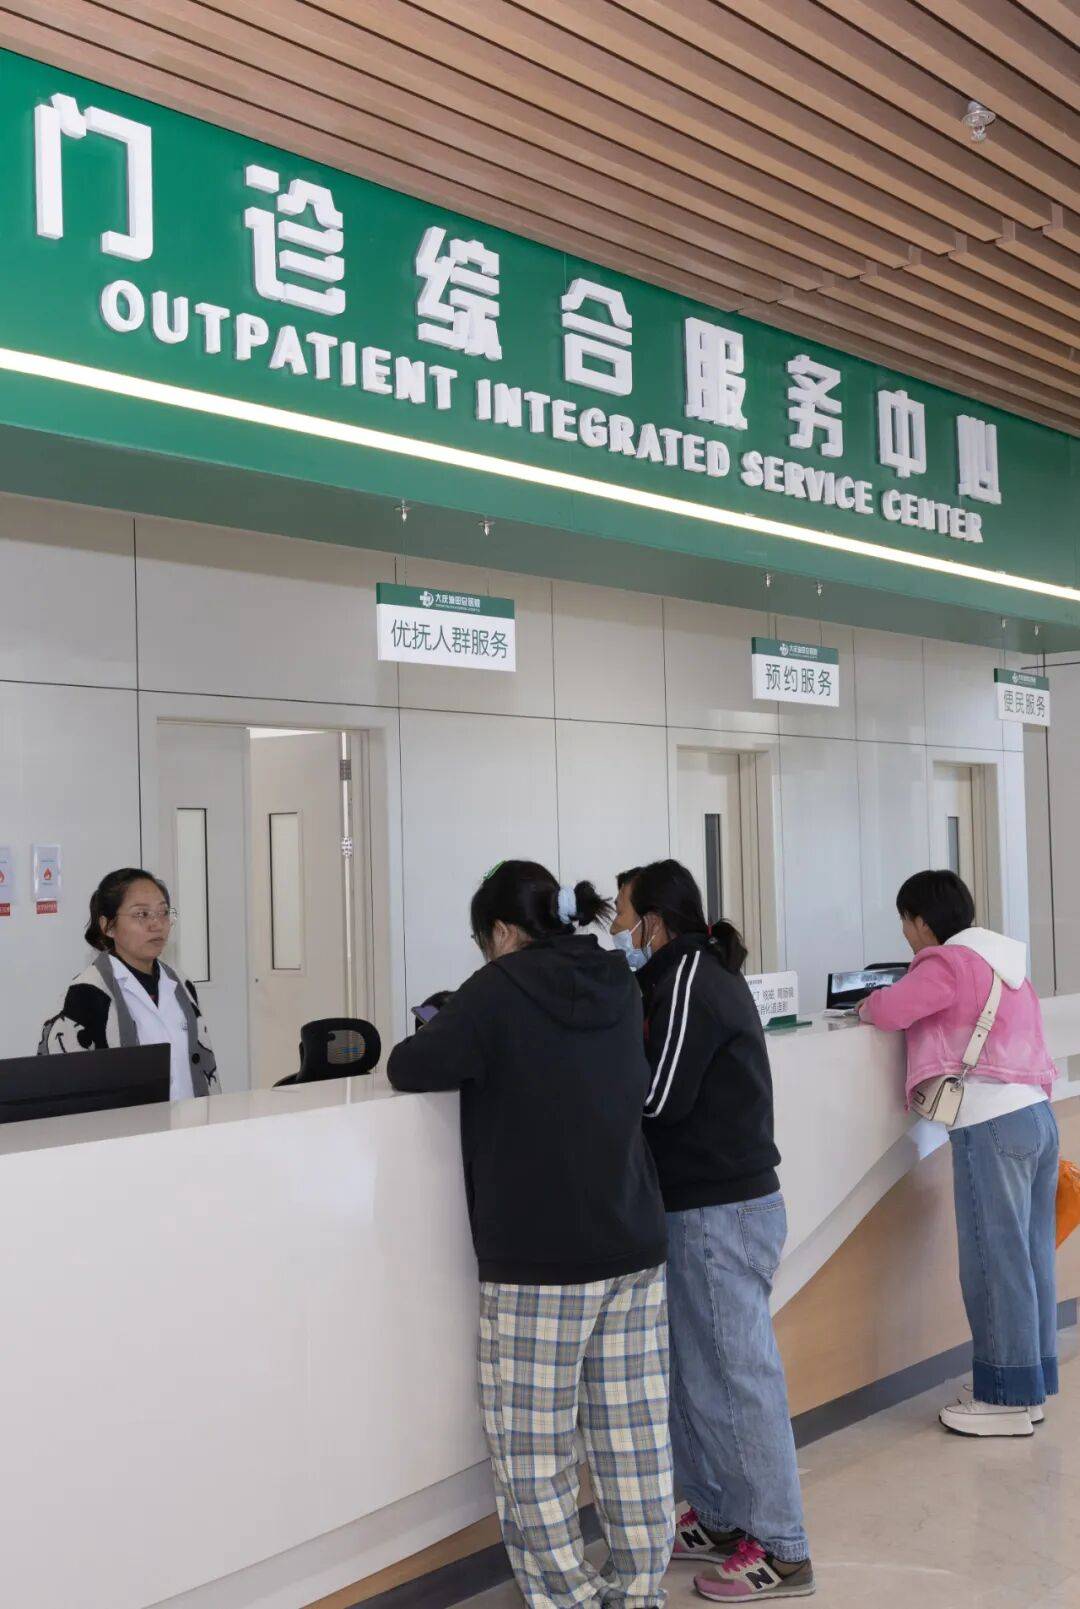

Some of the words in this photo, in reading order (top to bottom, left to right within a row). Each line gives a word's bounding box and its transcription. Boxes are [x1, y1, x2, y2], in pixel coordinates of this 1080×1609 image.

[34, 93, 1002, 505] 门诊综合服务中心
[100, 279, 458, 410] OUTPATIENT
[476, 378, 731, 477] INTEGRATED
[740, 450, 874, 515] SERVICE
[882, 489, 984, 543] CENTER
[391, 619, 508, 659] 优抚人群服务
[765, 663, 832, 696] 预约服务
[1004, 690, 1045, 718] 便民服务
[680, 1529, 706, 1549] N
[745, 1567, 775, 1590] N
